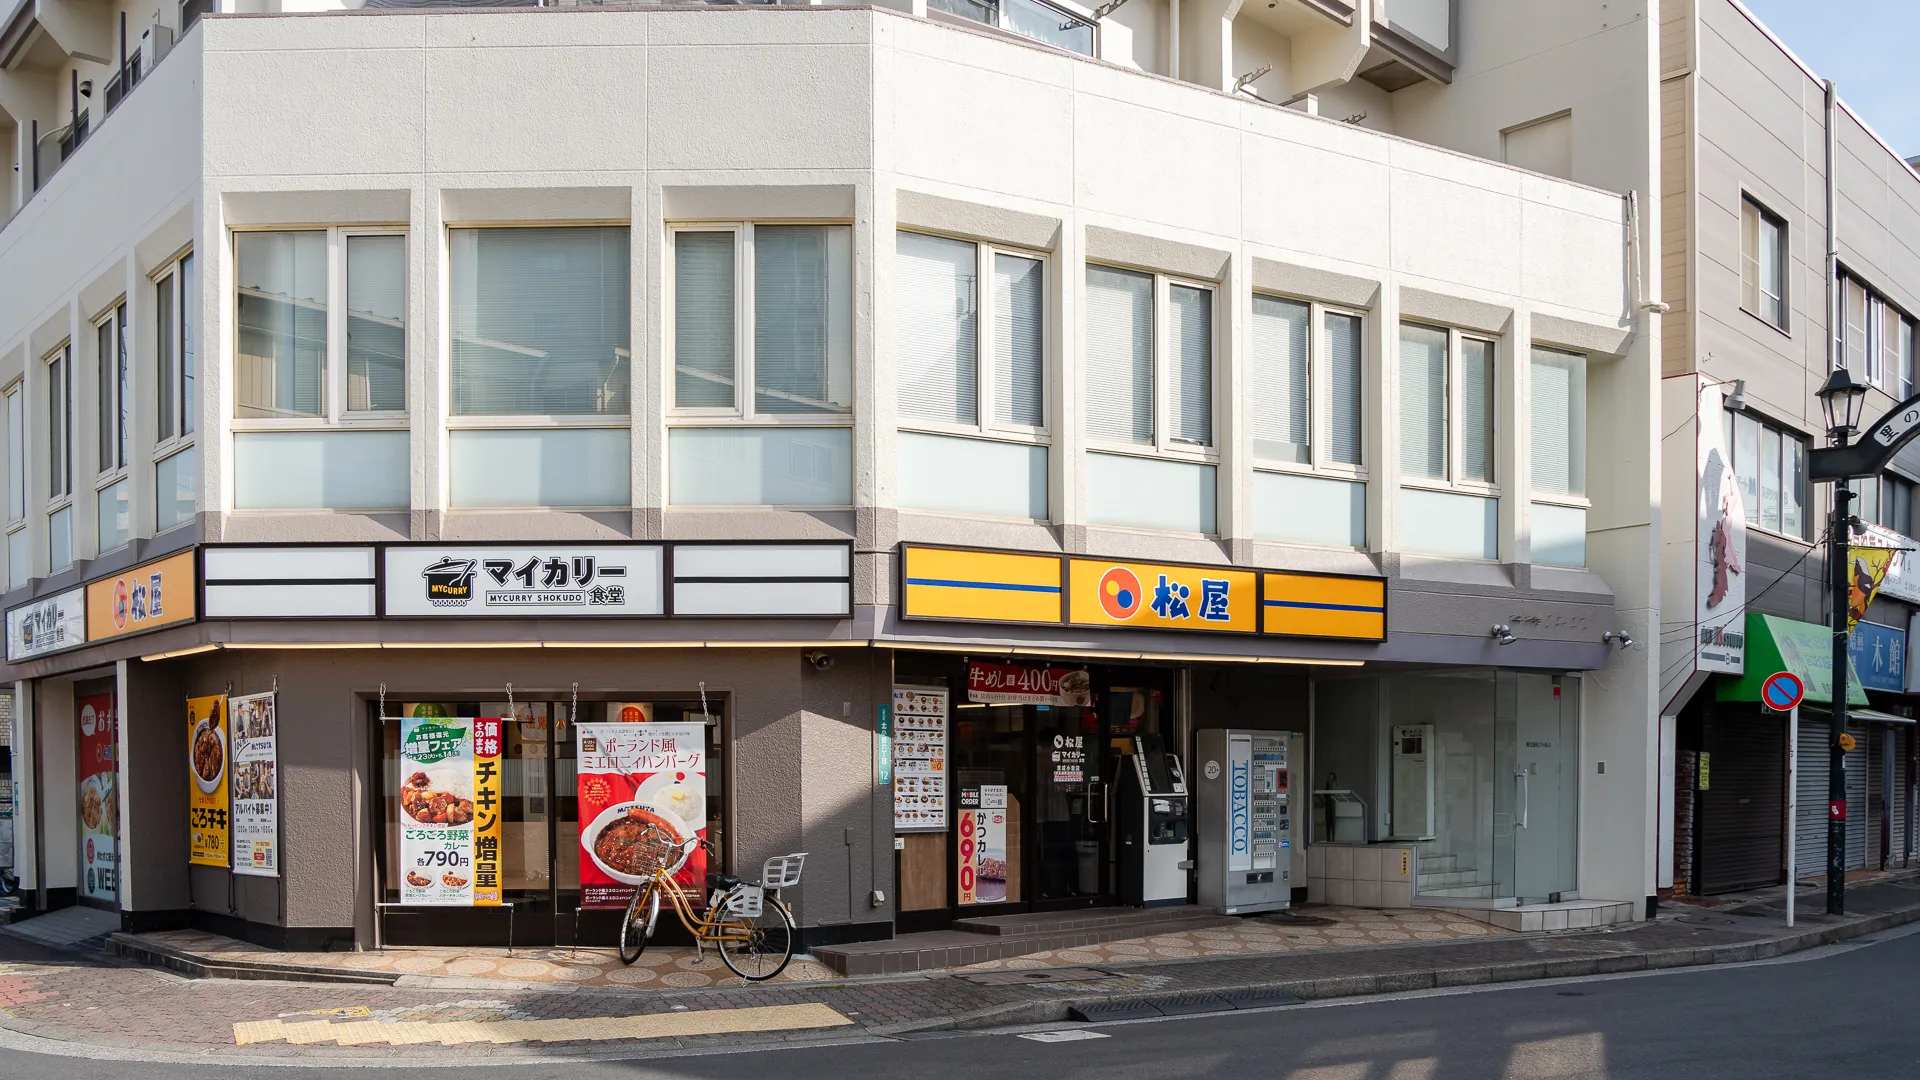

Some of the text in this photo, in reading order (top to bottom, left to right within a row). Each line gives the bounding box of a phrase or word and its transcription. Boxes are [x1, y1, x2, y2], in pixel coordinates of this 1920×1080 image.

[483, 556, 626, 588] マイカリー
[131, 572, 163, 622] 松屋
[431, 584, 468, 595] MYCURRY
[489, 594, 581, 602] MYCURRY SHOKUDO
[587, 585, 625, 606] 食堂
[1150, 574, 1230, 622] 松屋
[970, 667, 1005, 688] 牛めし
[1018, 669, 1058, 692] 400円
[404, 738, 462, 755] 増量フェア
[475, 722, 484, 754] そのまま
[484, 722, 498, 754] 価格
[605, 738, 677, 753] ポーランド風
[1065, 736, 1083, 748] 松屋
[583, 753, 701, 770] ミエロニィハンバーグ
[1207, 766, 1220, 774] 20+
[880, 771, 888, 780] 12
[235, 803, 273, 815] アルバイト募集中!
[1234, 762, 1247, 852] TOBACCO
[475, 761, 498, 888] チキン増量
[406, 829, 469, 840] ごろごろ野菜
[977, 812, 987, 876] かつカレー
[444, 842, 469, 850] カレー
[960, 813, 975, 902] 690円
